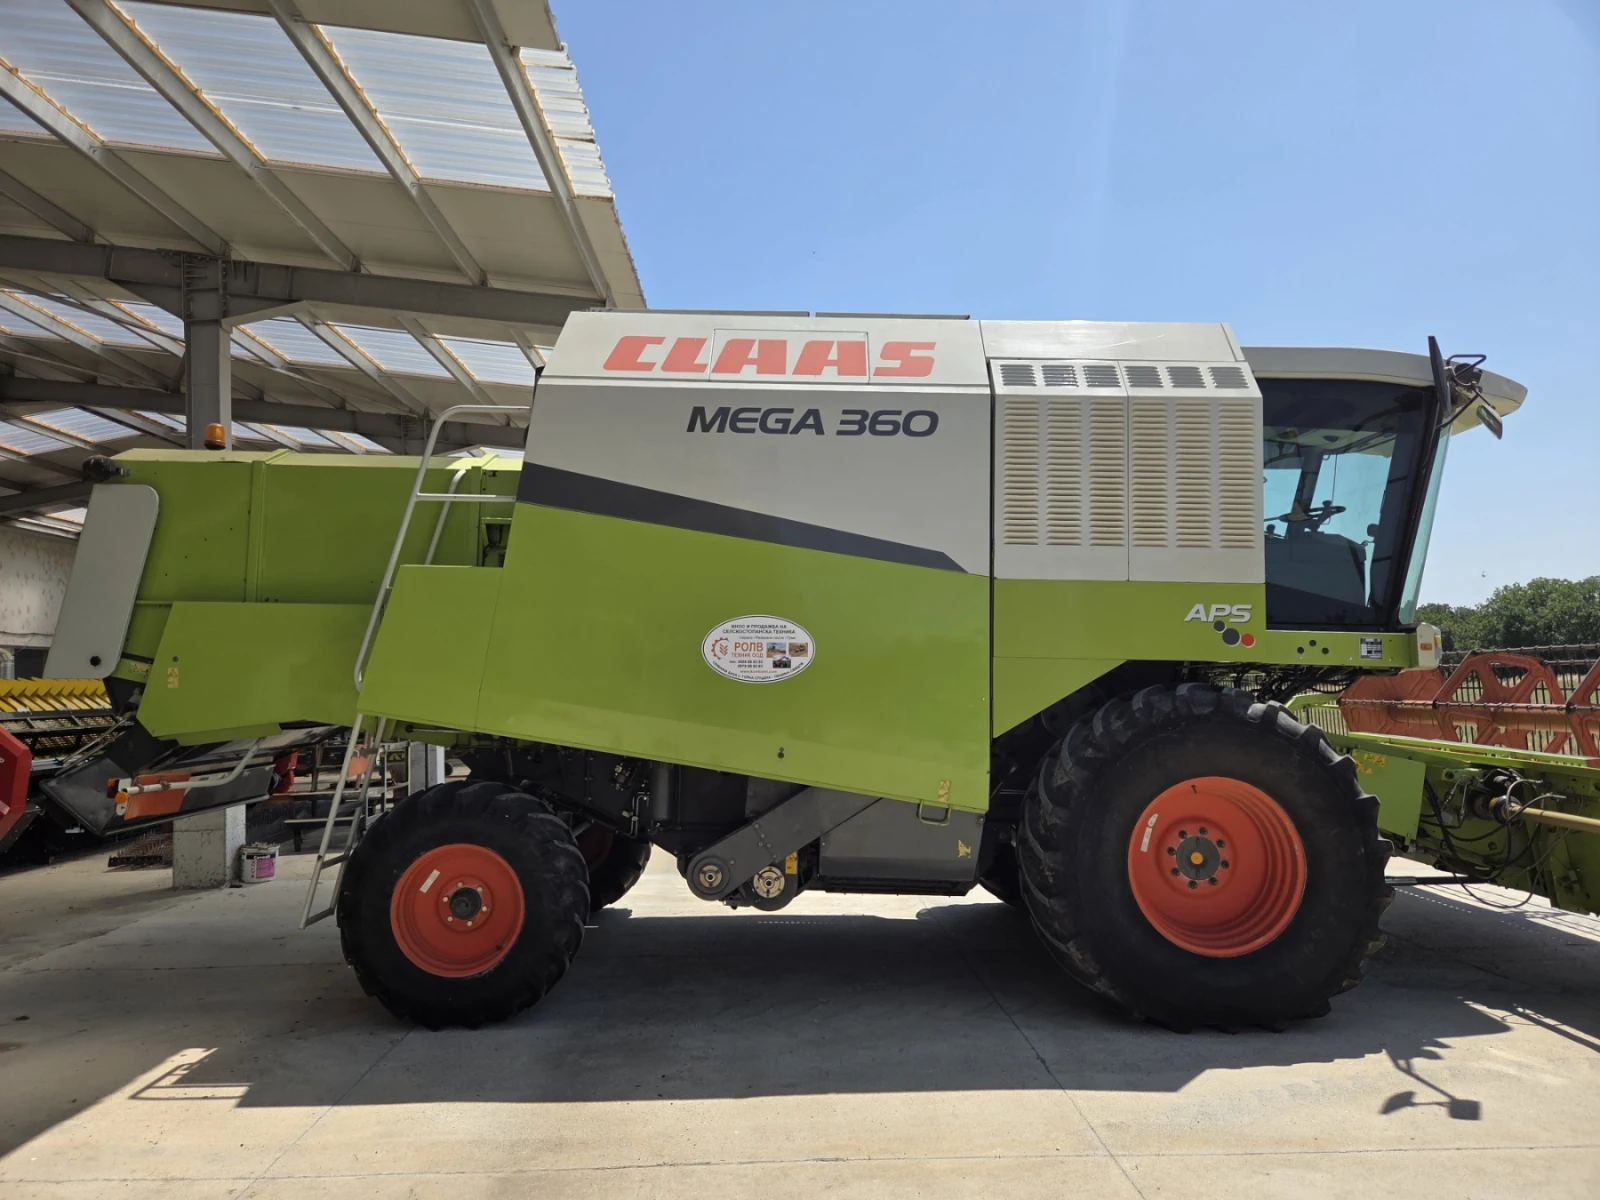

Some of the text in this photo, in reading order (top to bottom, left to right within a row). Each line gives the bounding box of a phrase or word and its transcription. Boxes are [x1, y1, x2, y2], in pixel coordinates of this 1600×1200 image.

[603, 336, 936, 377] CLAAS
[686, 406, 939, 437] MEGA 360
[1184, 603, 1253, 623] APS
[734, 642, 763, 652] РОЛВ
